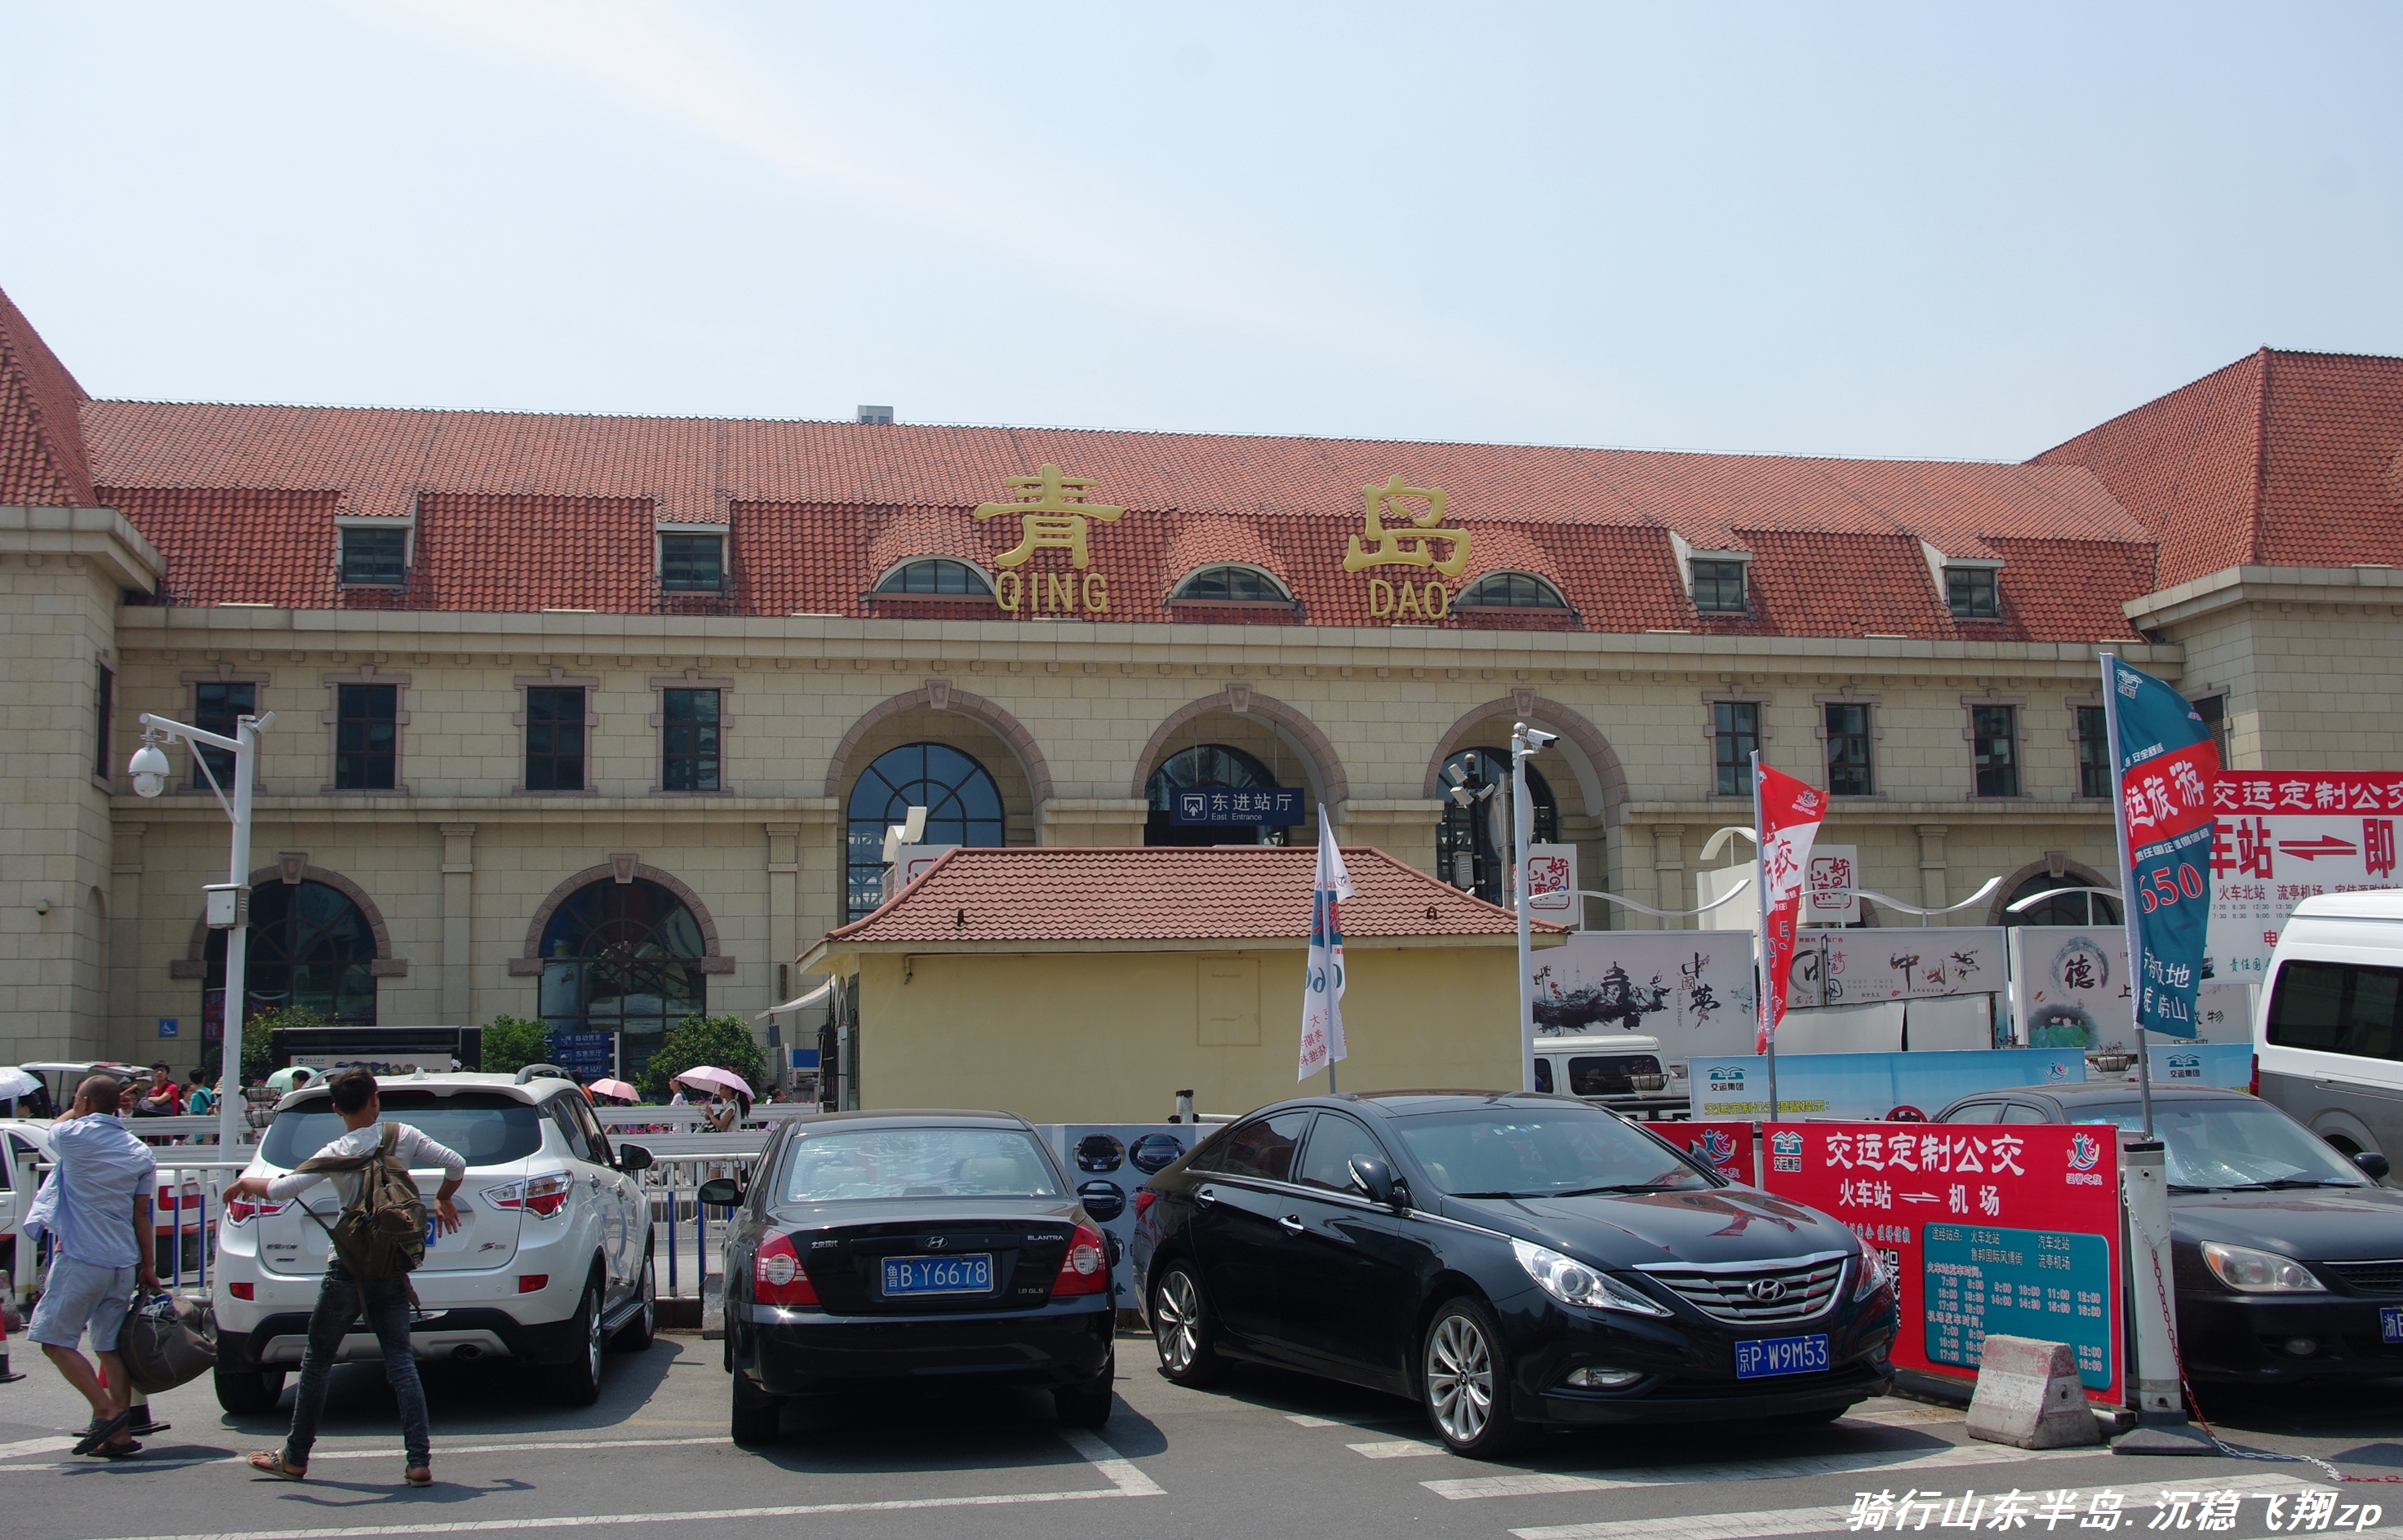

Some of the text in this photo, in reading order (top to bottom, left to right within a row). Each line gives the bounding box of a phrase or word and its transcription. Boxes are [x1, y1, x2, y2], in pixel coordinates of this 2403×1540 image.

[974, 464, 1471, 577] 青 岛
[995, 571, 1448, 619] QING DAO
[1210, 792, 1293, 811] 东进站厅
[2125, 760, 2205, 838] 运旅游
[1211, 813, 1263, 821] East Entrance
[2219, 884, 2266, 901] 火车北站
[2276, 884, 2324, 901] 流亭机场
[2064, 954, 2095, 989] 德
[2170, 1069, 2201, 1078] 交运集团
[1710, 1082, 1744, 1092] 交运集团
[1774, 1156, 1801, 1173] 交运集团
[1825, 1131, 2025, 1176] 交运定制公交
[2066, 1173, 2103, 1186] 温馨之旅
[1839, 1178, 2001, 1217] 火车站 机场
[811, 1240, 839, 1249] 北京现代
[1970, 1229, 2001, 1245] 火车北站
[2037, 1235, 2071, 1251] 汽车北站
[1970, 1247, 2071, 1271] 鲁邦国际风情街 流亭机场
[1941, 1276, 2101, 1304] 7:00 8:00 9:00 10:00 11:00 12:00
[1938, 1288, 2101, 1318] 13:00 13:30 14:00 14:30 15:00 16:00
[1938, 1300, 1985, 1315] 17:00 18:00
[1942, 1325, 1985, 1341] 7:00 8:00
[1939, 1337, 1959, 1349] 13:00
[2078, 1345, 2103, 1359] 12:00
[1939, 1349, 1959, 1361] 17:00
[2079, 1358, 2103, 1372] 16:00
